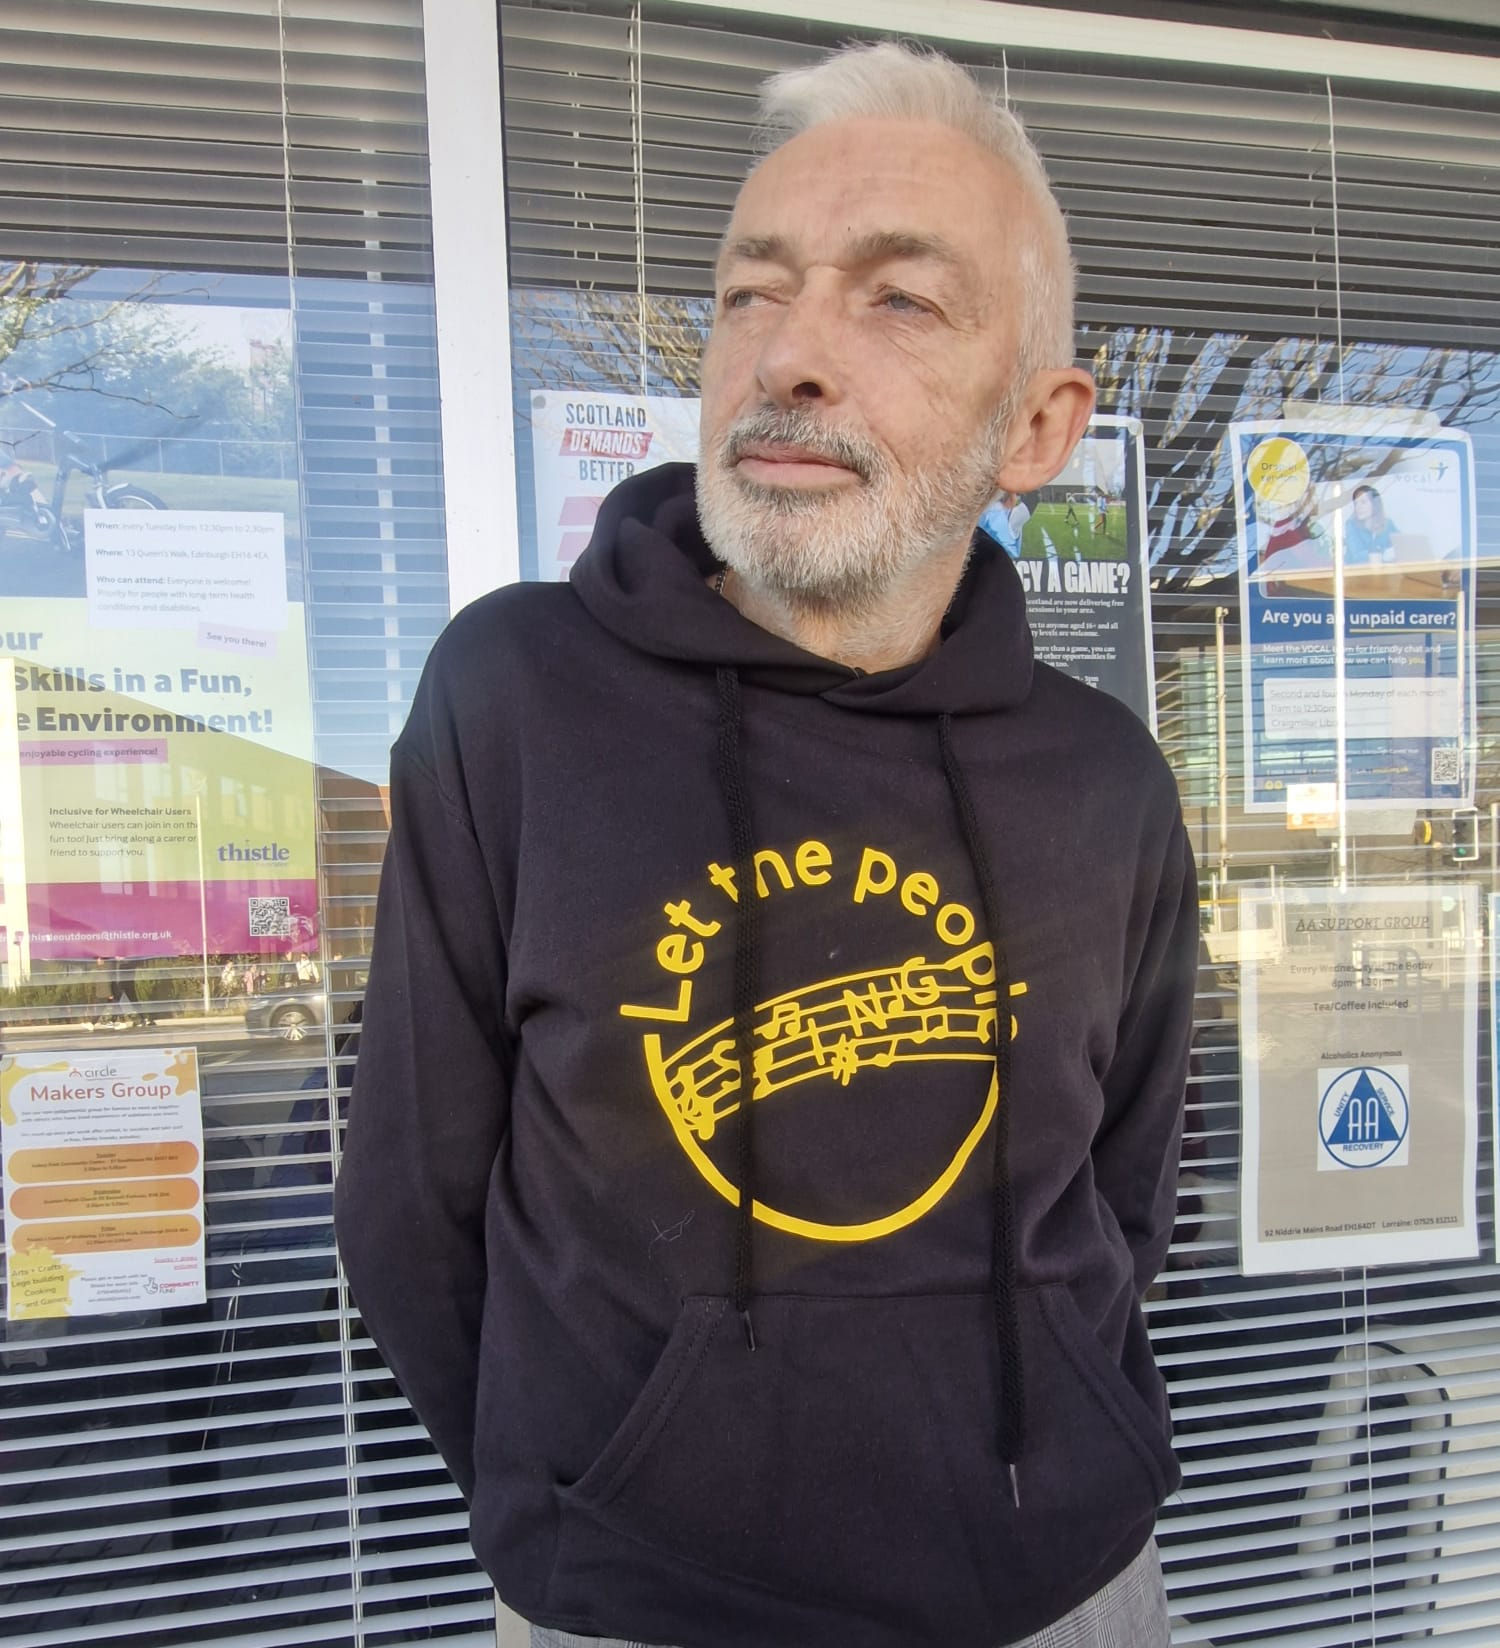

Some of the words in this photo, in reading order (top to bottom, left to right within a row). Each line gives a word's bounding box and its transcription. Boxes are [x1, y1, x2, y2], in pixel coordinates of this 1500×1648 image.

[566, 403, 647, 427] SCOTLAND
[570, 430, 644, 455] DEMANDS
[95, 522, 121, 530] When:
[96, 576, 115, 584] Who
[117, 577, 133, 585] can
[135, 577, 166, 585] attend:
[1013, 560, 1043, 593] CY
[1047, 560, 1062, 593] A
[1064, 560, 1131, 594] GAME?
[1261, 609, 1290, 624] Are
[1293, 612, 1323, 628] you
[1349, 610, 1406, 628] unpaid
[1409, 611, 1456, 626] carer?
[1263, 645, 1285, 654] Meet
[1301, 645, 1331, 653] VOCAL
[1263, 655, 1285, 665] learn
[15, 666, 106, 693] Skills
[113, 667, 146, 693] in
[153, 673, 172, 693] a
[179, 667, 252, 698] Fun,
[36, 706, 273, 734] Environment!
[67, 746, 102, 761] cycling
[49, 808, 93, 817] Inclusive
[95, 807, 110, 817] for
[110, 807, 162, 817] Wheelchair
[164, 808, 192, 817] Users
[49, 821, 99, 831] Wheelchair
[101, 823, 126, 831] users
[127, 823, 143, 831] can
[144, 821, 161, 832] join
[162, 822, 172, 831] in
[173, 823, 184, 831] on
[49, 835, 66, 844] fun
[130, 834, 155, 846] along
[164, 836, 187, 844] carer
[49, 848, 77, 857] friend
[78, 849, 88, 857] to
[217, 842, 290, 862] thistle
[1384, 916, 1430, 930] GROUP
[619, 899, 722, 1022] Let
[1313, 1001, 1366, 1012] Tea/Coffee
[84, 1065, 118, 1079] circle
[30, 1084, 106, 1102] Makers
[111, 1082, 172, 1100] Group
[1333, 1092, 1350, 1117] UNITY
[1377, 1087, 1396, 1117] SERVICE
[1347, 1097, 1380, 1141] AA
[1342, 1142, 1385, 1152] RECOVERY
[1275, 1228, 1301, 1237] Niddrie
